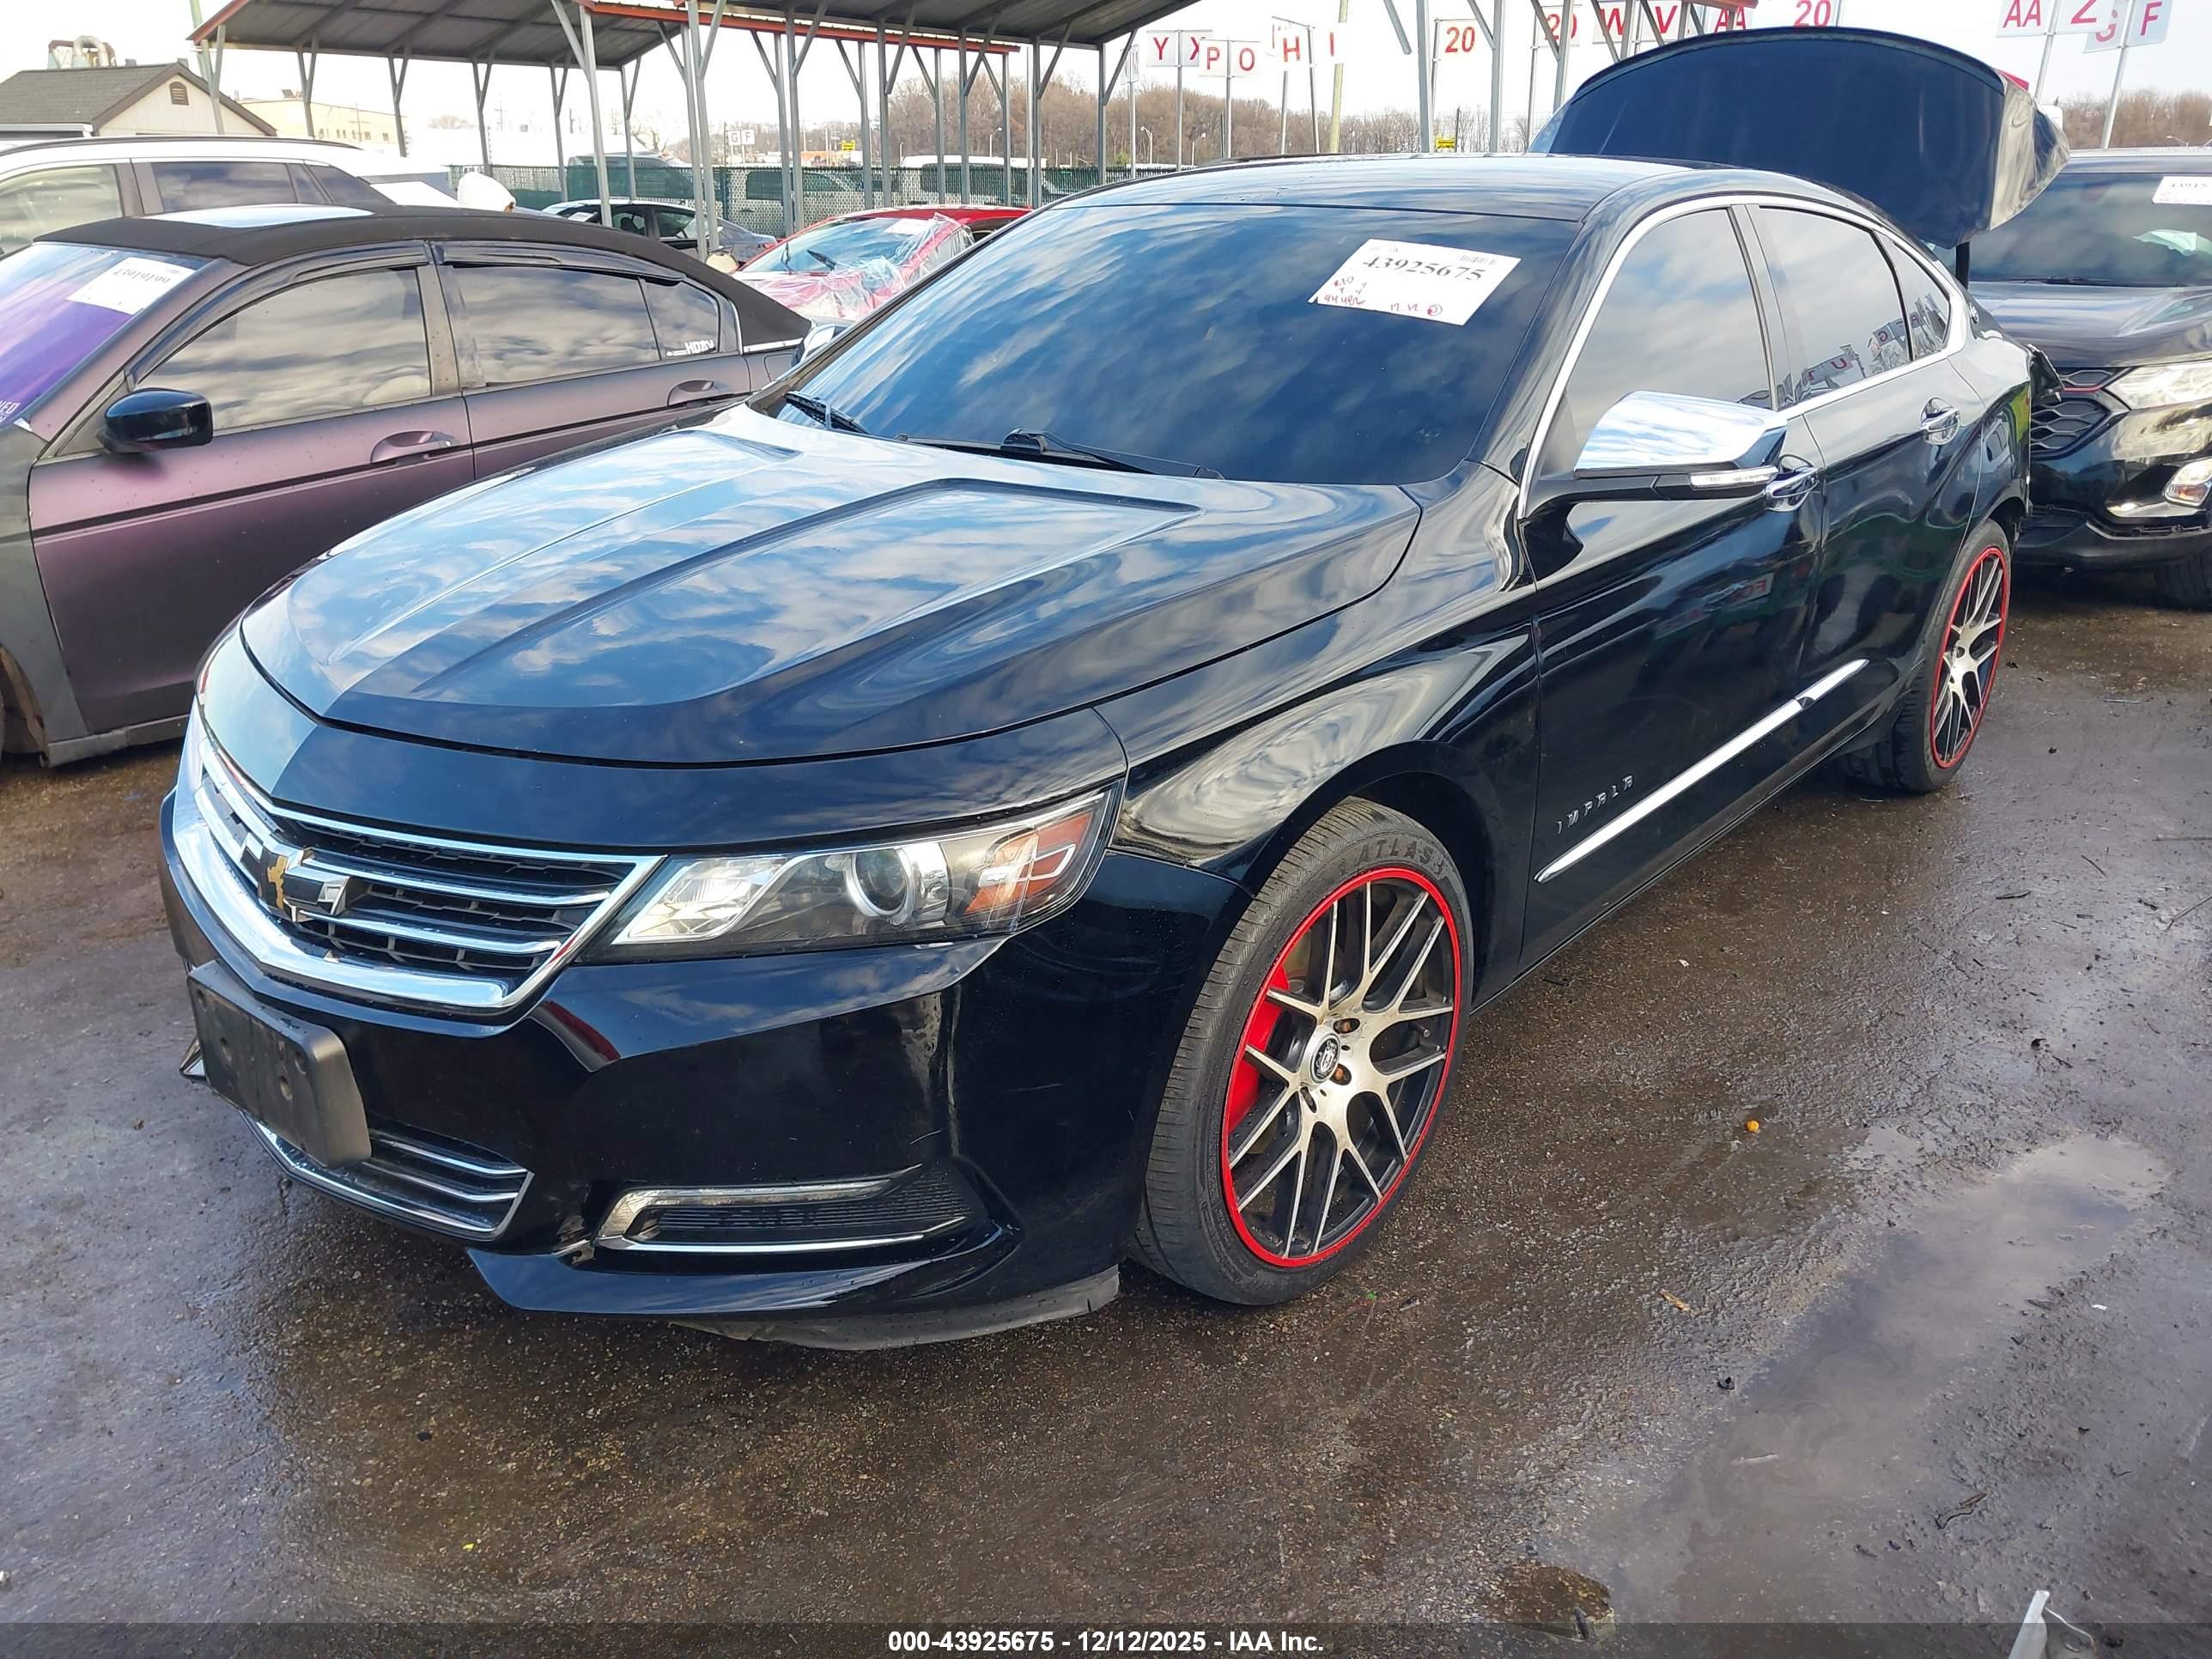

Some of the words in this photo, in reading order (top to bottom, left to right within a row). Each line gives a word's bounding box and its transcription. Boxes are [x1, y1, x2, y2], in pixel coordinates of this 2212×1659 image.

[1655, 5, 1678, 34] V
[1793, 0, 1832, 27] 20
[2002, 0, 2041, 28] AA
[2140, 1, 2163, 36] F
[1152, 37, 1170, 60] Y
[1283, 35, 1300, 63] H
[1444, 26, 1476, 53] 20
[1206, 46, 1221, 70] P
[1238, 47, 1255, 71] O
[1363, 256, 1486, 282] 43925675
[1556, 775, 1634, 835] IMPALA
[1354, 836, 1434, 866] ATLAS
